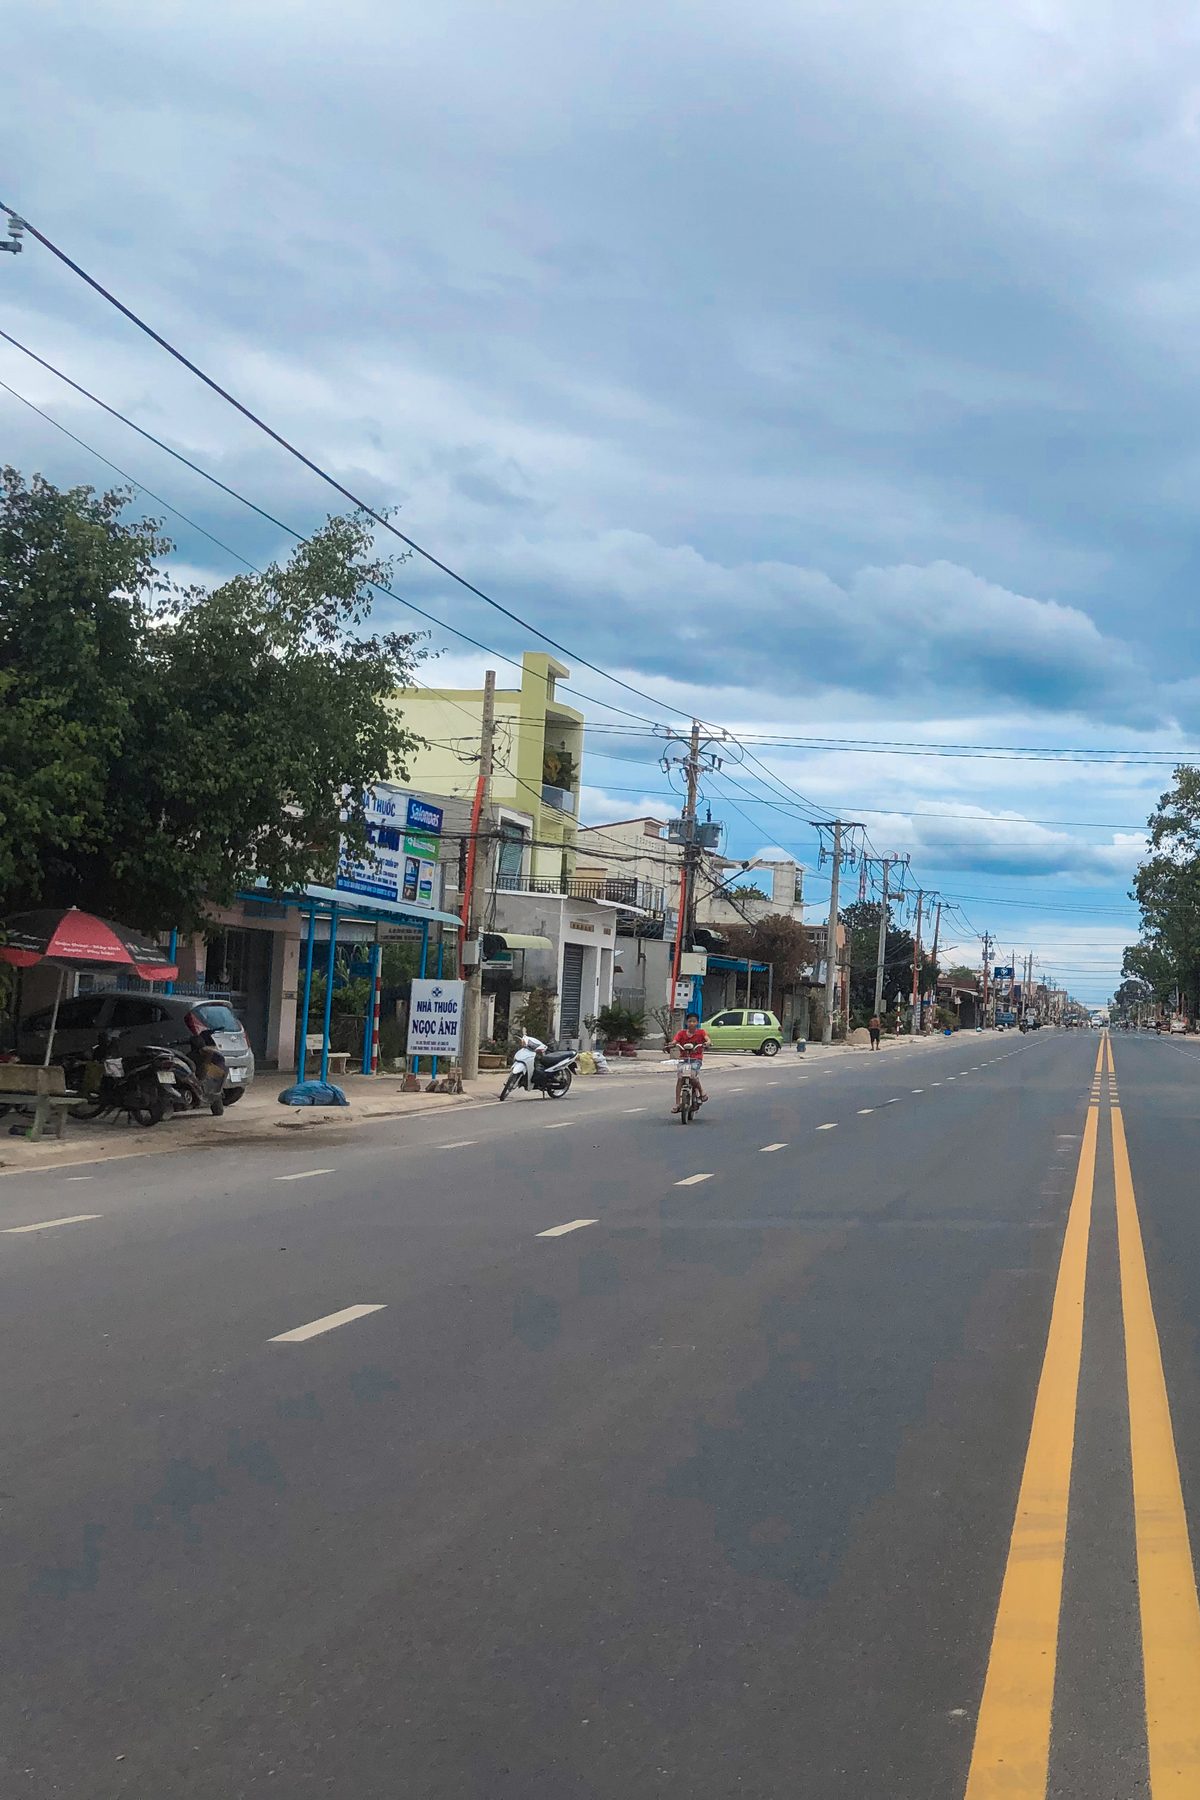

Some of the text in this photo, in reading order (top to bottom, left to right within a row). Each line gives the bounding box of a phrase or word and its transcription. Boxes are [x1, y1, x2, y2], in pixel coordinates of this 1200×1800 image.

[416, 998, 458, 1013] NHÀ THUỐC
[412, 1019, 436, 1038] NGỌC
